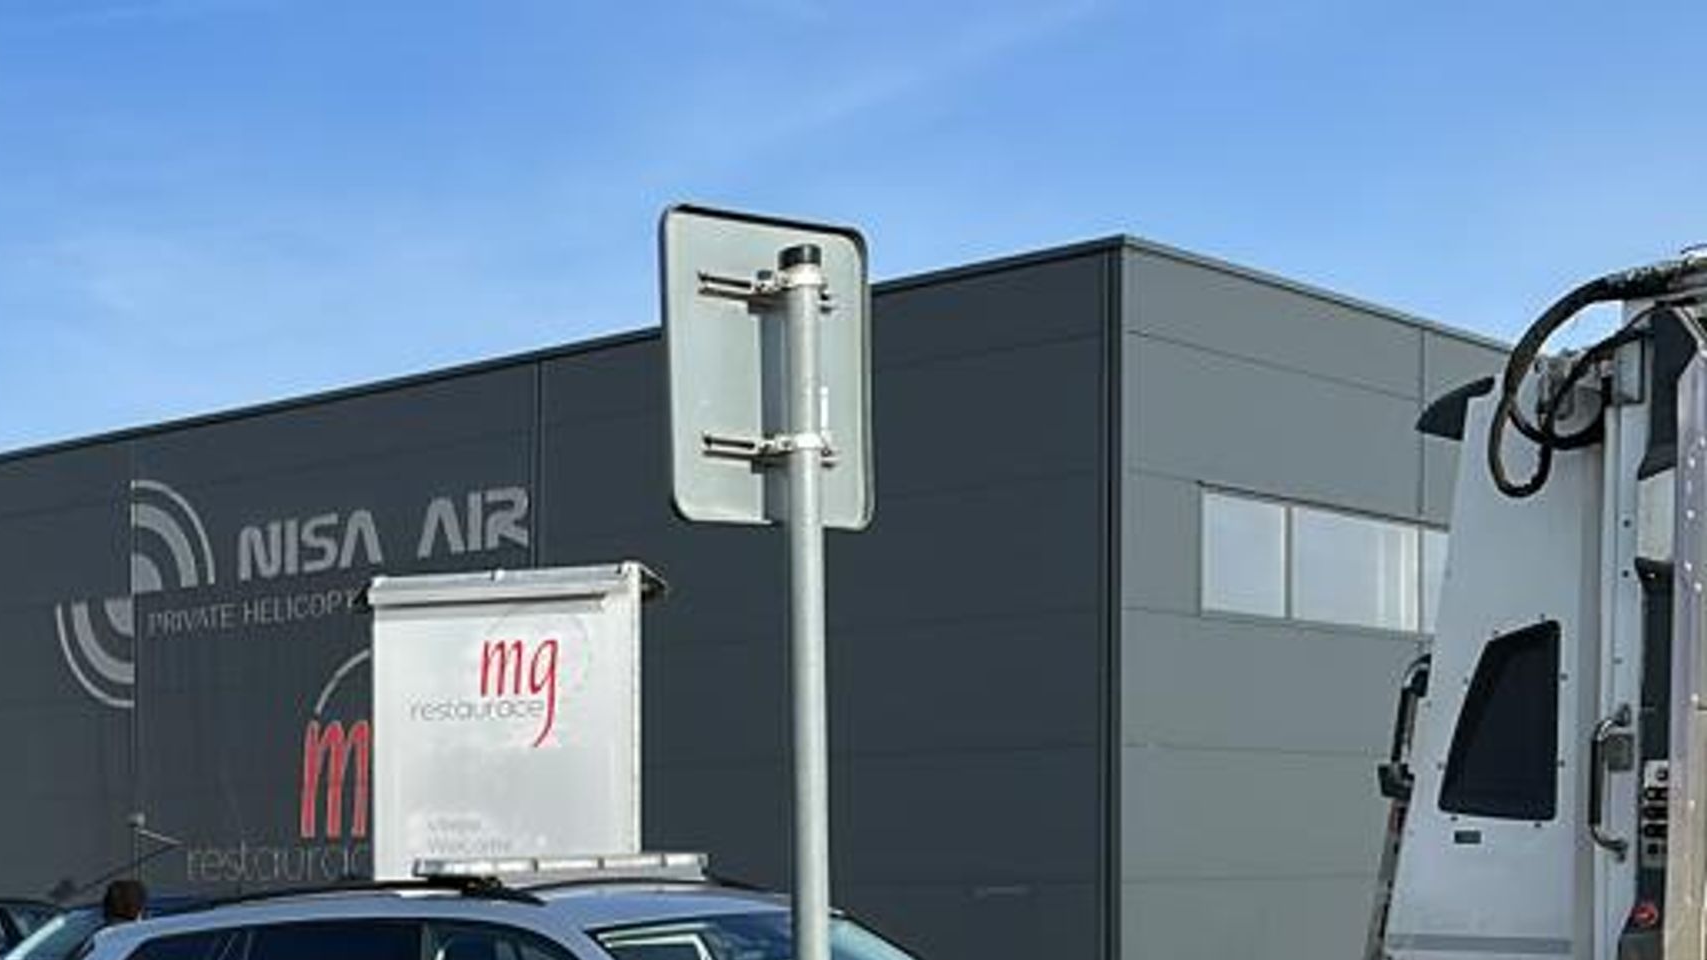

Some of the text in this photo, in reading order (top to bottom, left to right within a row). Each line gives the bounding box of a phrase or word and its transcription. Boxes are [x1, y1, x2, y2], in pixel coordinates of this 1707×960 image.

[239, 485, 529, 582] NISA AIR
[147, 602, 238, 636] PRIVATE
[409, 696, 544, 722] restaurace
[186, 840, 372, 882] restaurac
